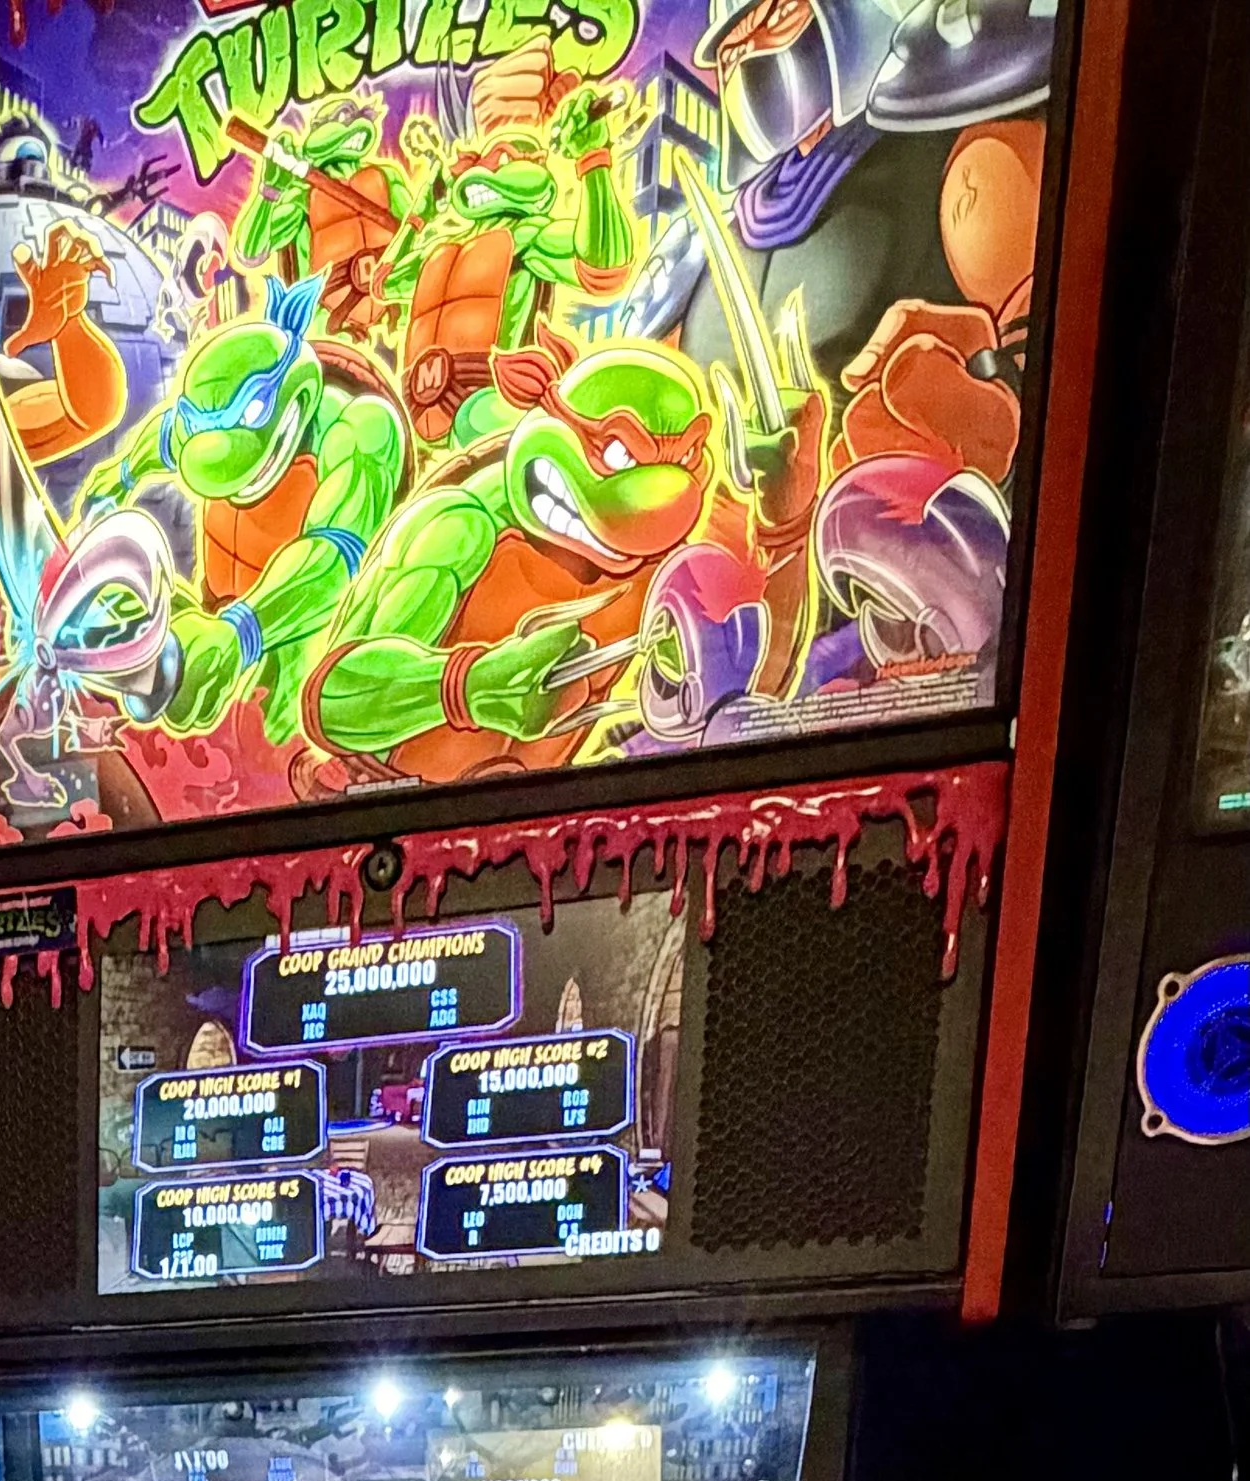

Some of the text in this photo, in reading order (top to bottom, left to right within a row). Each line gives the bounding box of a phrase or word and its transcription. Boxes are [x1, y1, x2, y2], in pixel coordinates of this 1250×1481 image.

[136, 0, 635, 180] TURTLES
[416, 355, 444, 394] M
[279, 931, 486, 977] COOP GRAND CHAMPIONS
[323, 959, 437, 996] 25,000,000
[450, 1039, 610, 1073] COOP HIGH SCORE #2
[159, 1079, 197, 1101] COOP
[200, 1075, 236, 1097] HIGH
[236, 1071, 281, 1093] SCORE
[478, 1062, 579, 1093] 15,000,000
[183, 1091, 277, 1121] 20,000,000
[445, 1164, 486, 1186] COOP
[488, 1159, 527, 1182] HIGH
[527, 1156, 577, 1179] SCORE
[156, 1188, 195, 1208] COOP
[196, 1183, 231, 1204] HIGH
[232, 1180, 277, 1201] SCORE
[478, 1178, 568, 1206] 7,500,000
[182, 1201, 274, 1228] 10,000,000
[564, 1228, 644, 1257] CREDITS
[645, 1227, 661, 1251] 0
[159, 1253, 218, 1279] 1/1.00
